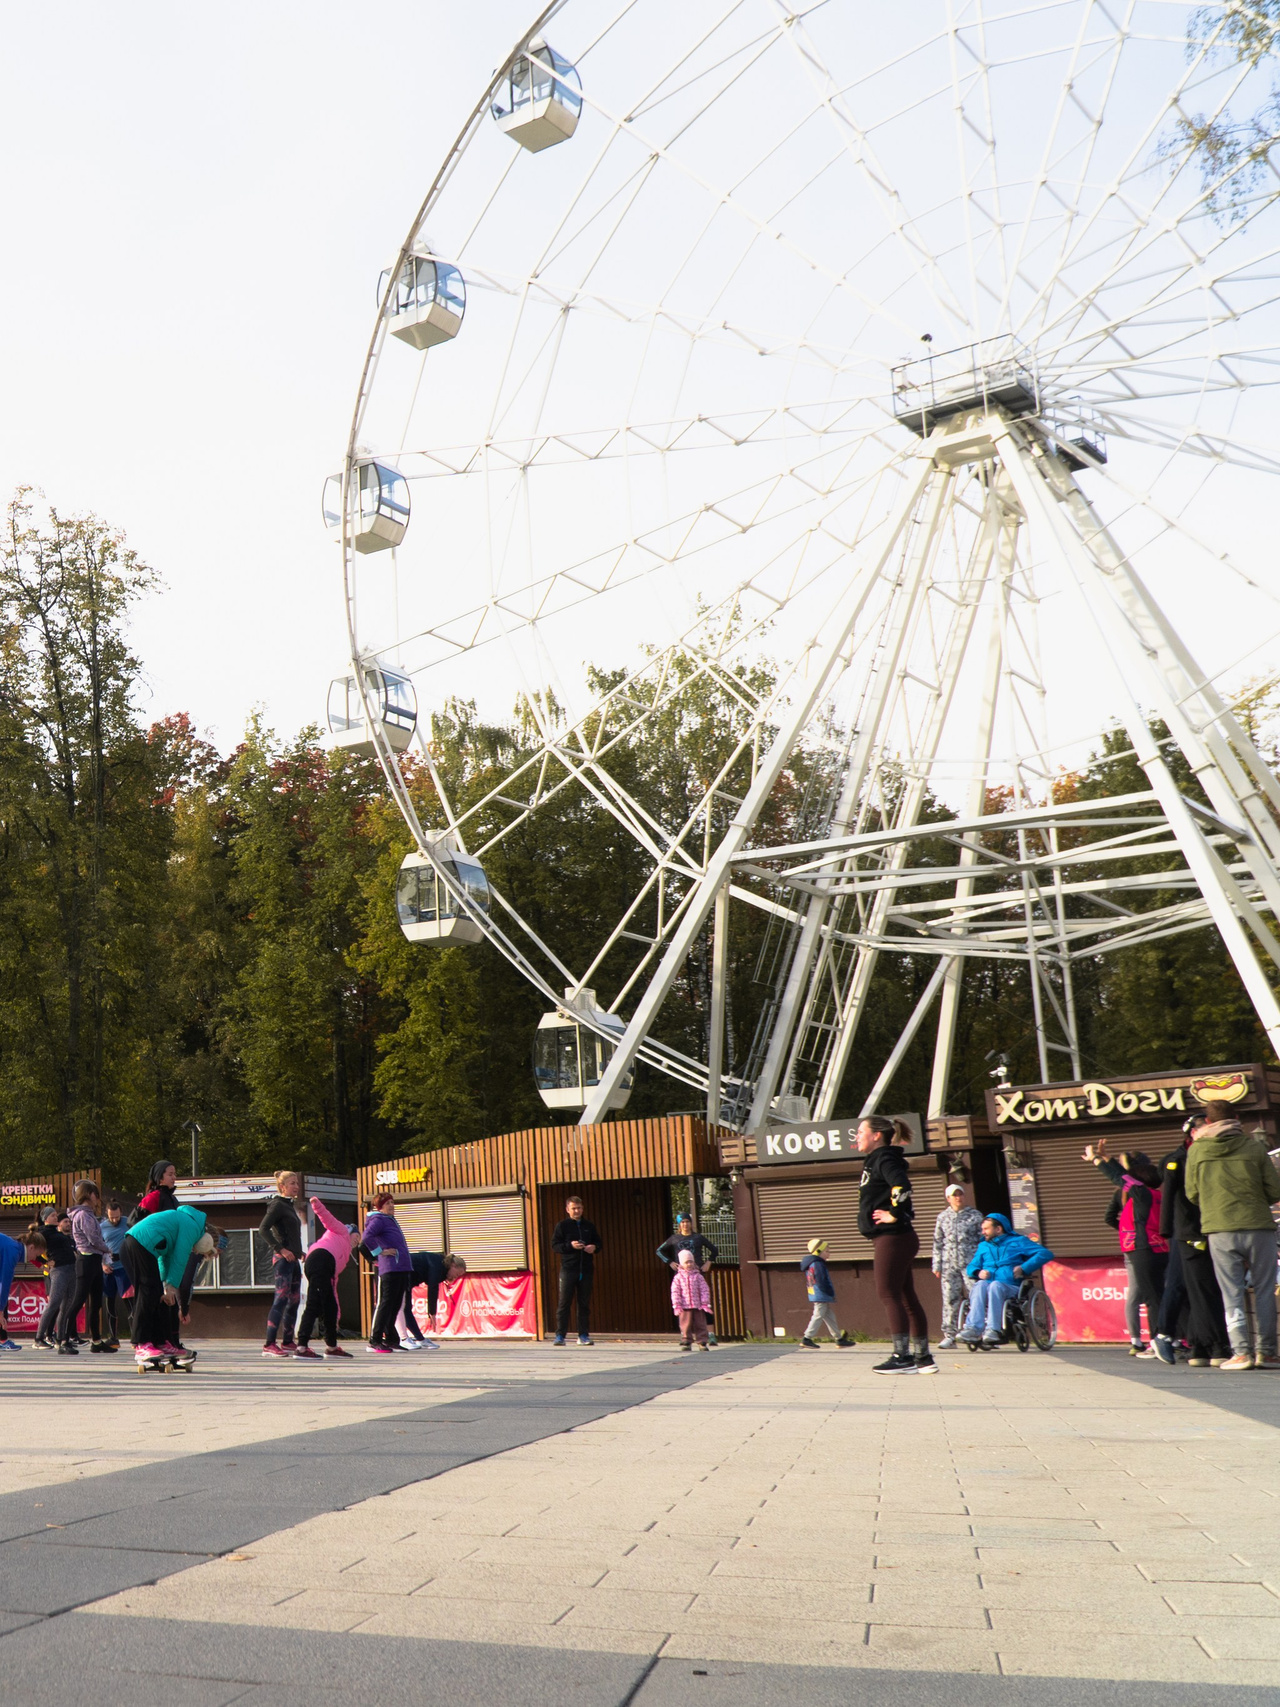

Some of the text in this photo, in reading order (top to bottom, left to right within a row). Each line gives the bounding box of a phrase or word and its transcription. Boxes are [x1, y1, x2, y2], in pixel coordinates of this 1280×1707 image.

[995, 1083, 1186, 1124] Хот-Доги
[766, 1129, 842, 1156] КОФЕ
[375, 1167, 428, 1186] SUBWAY
[1, 1184, 54, 1196] КРЕВЕТКИ
[0, 1194, 56, 1206] СЭНДВИЧИ
